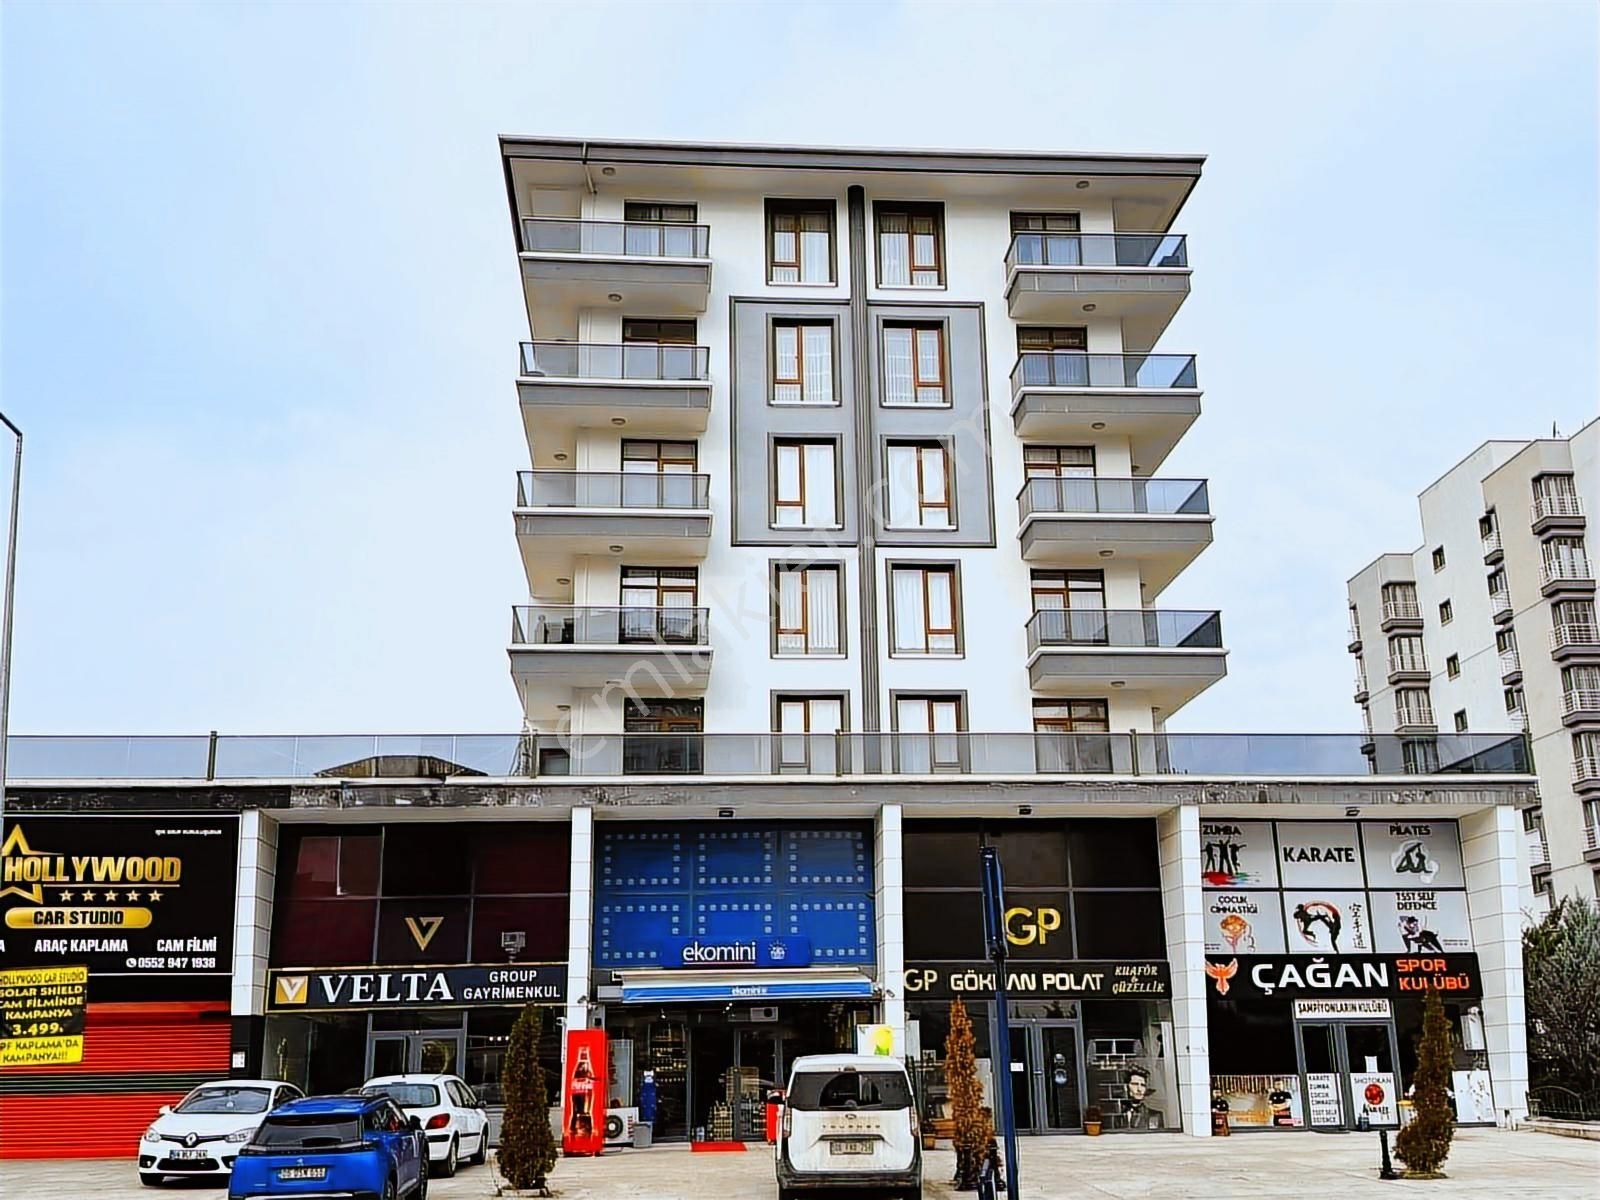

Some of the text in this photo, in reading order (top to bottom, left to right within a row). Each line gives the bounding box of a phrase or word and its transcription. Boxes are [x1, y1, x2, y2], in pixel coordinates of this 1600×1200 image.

[1202, 825, 1242, 836] ZUMBA
[1389, 822, 1432, 835] PİLATES
[1283, 847, 1355, 862] KARATE
[4, 857, 182, 882] HOLLYWOOD
[34, 910, 124, 925] CAR STUDIO
[1005, 907, 1061, 945] GP
[34, 939, 128, 955] ARAÇ KAPLAMA
[157, 937, 217, 952] CAM FİLMİ
[683, 941, 756, 961] ekomini
[138, 958, 216, 969] 0552 947 1938
[1396, 958, 1447, 972] SPOR
[489, 970, 537, 984] GROUP
[904, 969, 938, 991] GP
[1043, 973, 1104, 991] POLAT
[1251, 957, 1389, 996] ÇAĞAN
[319, 972, 454, 1003] VELTA
[463, 983, 561, 1000] GAYRİMENKUL
[26, 996, 84, 1008] FİLMİNDE
[1358, 1000, 1388, 1013] KULÜBÜ
[5, 1009, 73, 1020] KAMPANYA
